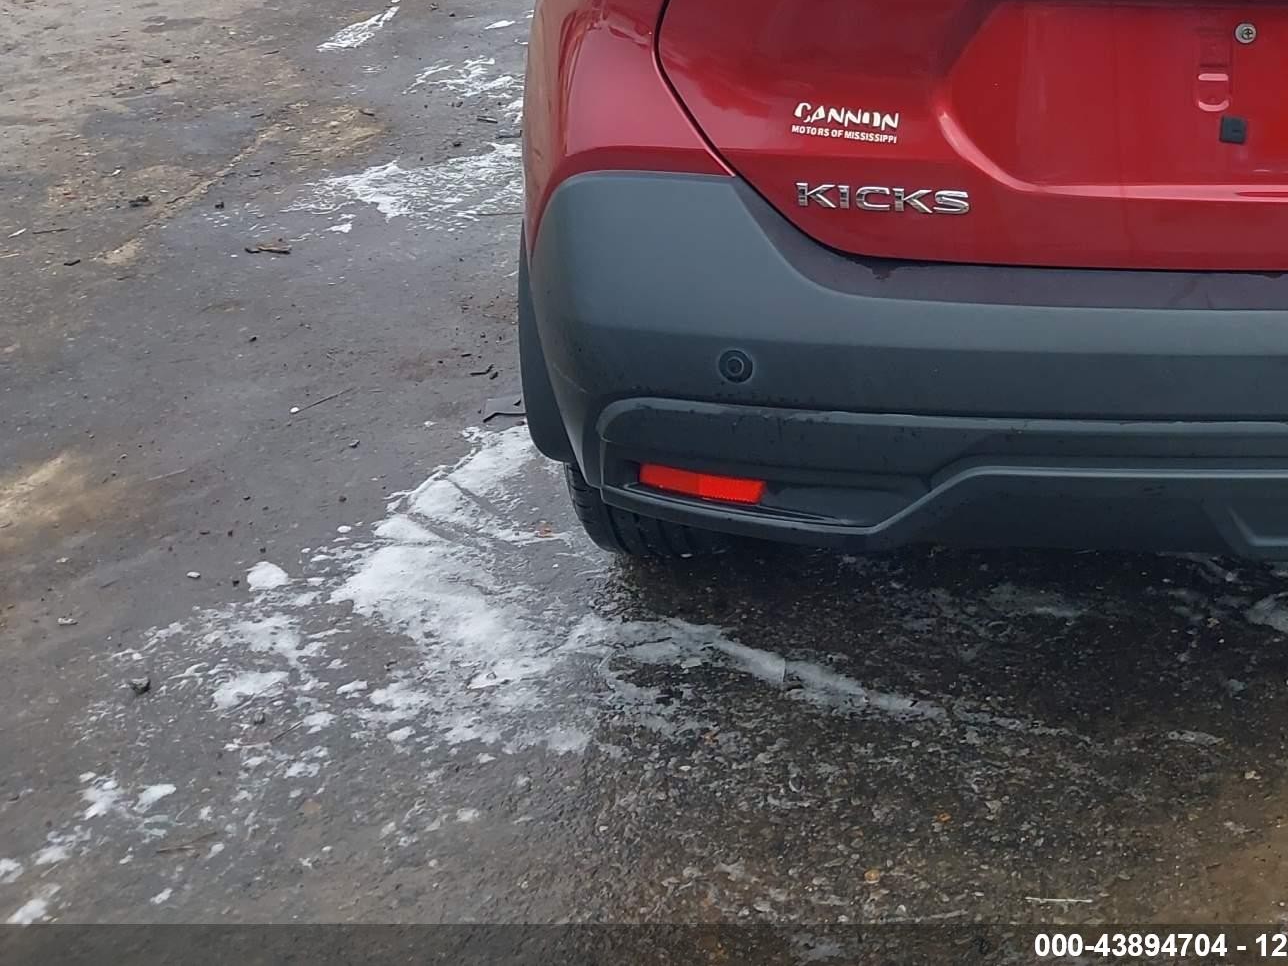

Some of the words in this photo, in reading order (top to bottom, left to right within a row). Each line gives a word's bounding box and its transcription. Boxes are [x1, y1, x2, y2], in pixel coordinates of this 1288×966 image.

[793, 102, 900, 131] CANNON
[791, 124, 830, 137] MOTORS
[831, 128, 844, 138] OF
[844, 130, 897, 144] MISSISSIPPI
[796, 182, 970, 214] KICKS
